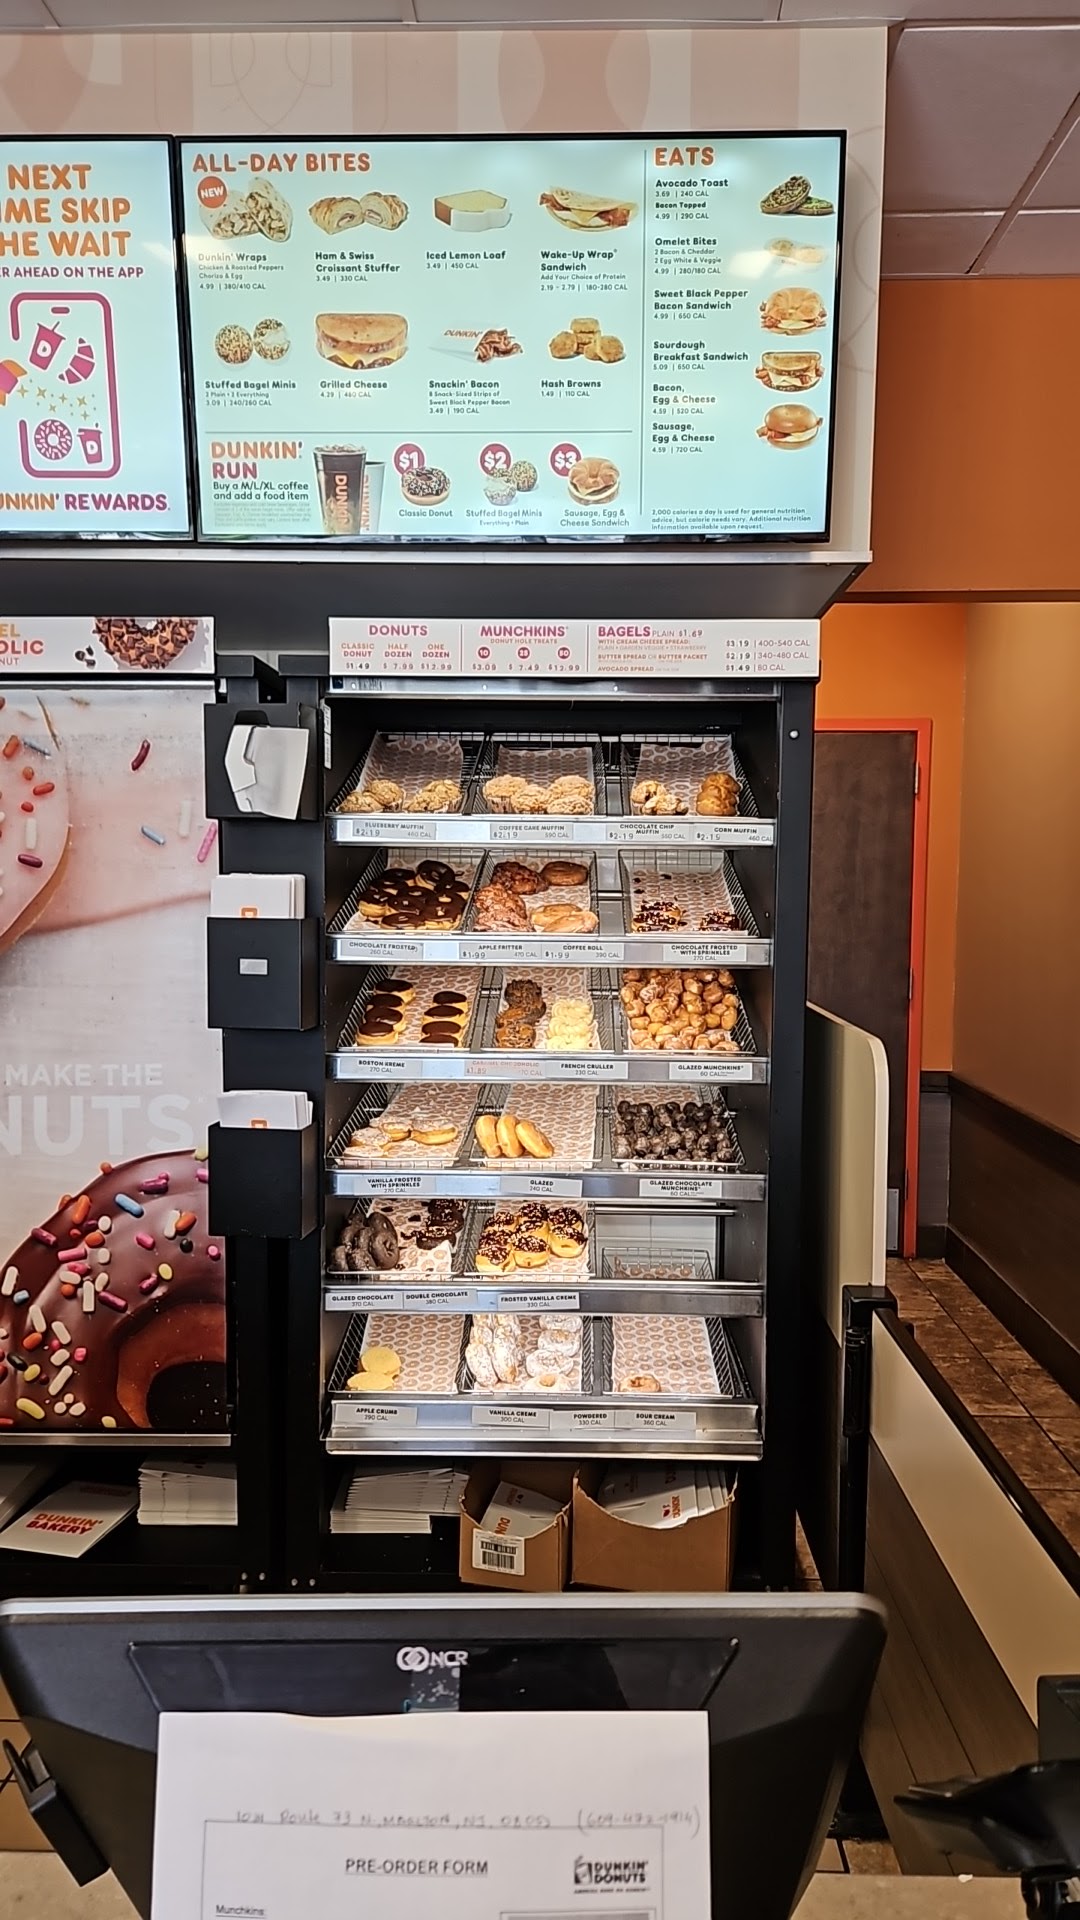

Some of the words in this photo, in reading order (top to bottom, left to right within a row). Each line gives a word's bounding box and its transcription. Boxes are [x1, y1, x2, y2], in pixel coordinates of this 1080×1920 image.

[654, 147, 715, 166] EATS
[192, 153, 298, 172] ALL-DAY
[305, 153, 371, 172] BITES
[8, 164, 92, 190] NEXT
[655, 179, 698, 187] Avocado
[700, 178, 729, 187] Toast
[200, 186, 225, 199] NEW
[0, 198, 52, 223] ME
[61, 198, 131, 223] SKIP
[48, 231, 131, 256] WAIT
[654, 238, 691, 246] Omelet
[693, 237, 717, 246] Bites
[198, 253, 235, 261] Dunkin'
[236, 253, 267, 262] Wraps
[315, 252, 337, 260] Ham
[349, 251, 375, 260] Swiss
[426, 251, 447, 260] Iced
[449, 251, 481, 260] Lemon
[483, 250, 506, 260] Loaf
[541, 250, 585, 259] Wake-Up
[316, 264, 362, 272] Croissant
[364, 264, 400, 272] Stuffer
[541, 262, 587, 271] Sandwich
[14, 267, 59, 277] AHEAD
[63, 267, 84, 277] ON
[88, 267, 117, 277] THE
[118, 267, 144, 277] APP
[654, 289, 684, 298] Sweet
[686, 289, 712, 298] Black
[714, 290, 749, 300] Pepper
[654, 302, 683, 310] Bacon
[685, 301, 732, 310] Sandwich
[653, 341, 705, 351] Sourdough
[653, 353, 701, 361] Breakfast
[703, 352, 748, 361] Sandwich
[205, 381, 241, 389] Stuffed
[243, 381, 270, 390] Bagel
[272, 381, 297, 389] Minis
[320, 381, 351, 389] Grilled
[354, 381, 388, 389] Cheese
[429, 380, 469, 388] Snackin'
[471, 380, 499, 388] Bacon
[541, 380, 565, 388] Hash
[567, 380, 601, 388] Browns
[653, 384, 685, 393] Bacon,
[652, 396, 670, 405] Egg
[682, 395, 716, 404] Cheese
[652, 423, 695, 432] Sausage,
[652, 435, 670, 444] Egg
[681, 434, 715, 443] Cheese
[211, 441, 303, 459] DUNKIN'
[399, 451, 419, 470] $1
[484, 451, 507, 470] $2
[555, 451, 577, 470] $3
[212, 462, 258, 479] RUN
[213, 482, 230, 490] Buy
[241, 482, 275, 490] M/L/XL
[277, 482, 309, 490] coffee
[214, 491, 231, 500] and
[234, 491, 252, 500] add
[264, 491, 285, 500] food
[287, 491, 309, 500] item
[398, 509, 427, 517] Classic
[429, 509, 453, 517] Donut
[466, 509, 496, 517] Stuffed
[498, 509, 520, 518] Bagel
[522, 509, 542, 517] Minis
[564, 509, 601, 518] Sausage,
[603, 509, 617, 518] Egg
[560, 519, 590, 527] Cheese
[592, 519, 629, 527] Sandwich
[368, 625, 428, 636] DONUTS
[598, 626, 650, 637] BAGELS
[384, 650, 412, 658] DOZEN
[5, 1064, 92, 1086] MAKE
[102, 1063, 163, 1086] THE
[34, 1513, 104, 1526] DUNKIN'
[26, 1520, 93, 1535] BAKERY
[430, 1651, 469, 1667] NCR
[345, 1858, 439, 1875] PRE-ORDER
[443, 1860, 489, 1876] FORM
[594, 1861, 649, 1872] DUNKIN'
[594, 1873, 646, 1884] DONUTS
[215, 1904, 265, 1917] Munchkins
